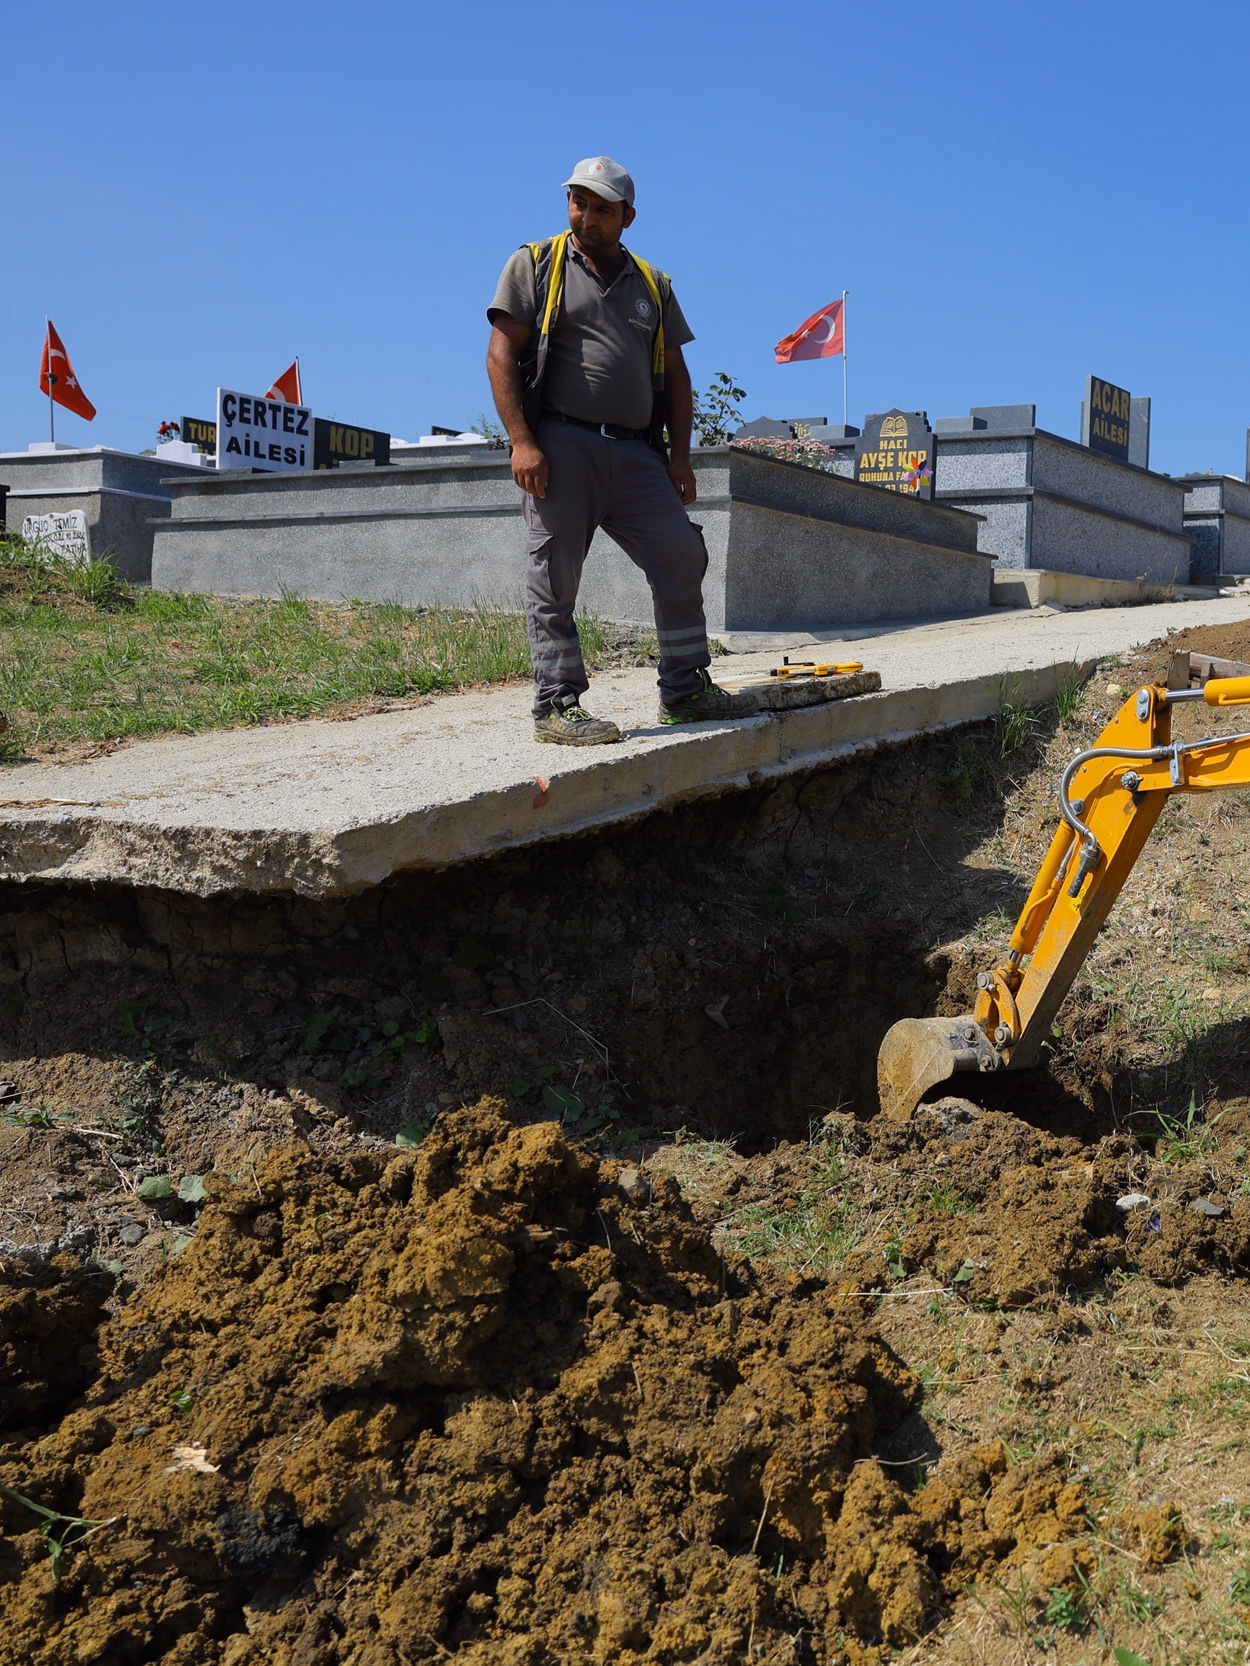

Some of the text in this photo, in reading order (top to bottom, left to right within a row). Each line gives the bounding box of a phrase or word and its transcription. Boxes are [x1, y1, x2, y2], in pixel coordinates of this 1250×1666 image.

[222, 393, 309, 437] ÇERTEZ
[1092, 379, 1130, 421] ACAR
[329, 425, 374, 458] KOP
[879, 439, 908, 450] HACI
[1093, 413, 1128, 447] AİLESİ
[225, 432, 306, 467] AİLESİ
[859, 451, 896, 471] AYŞE
[859, 471, 895, 482] RUHUNA
